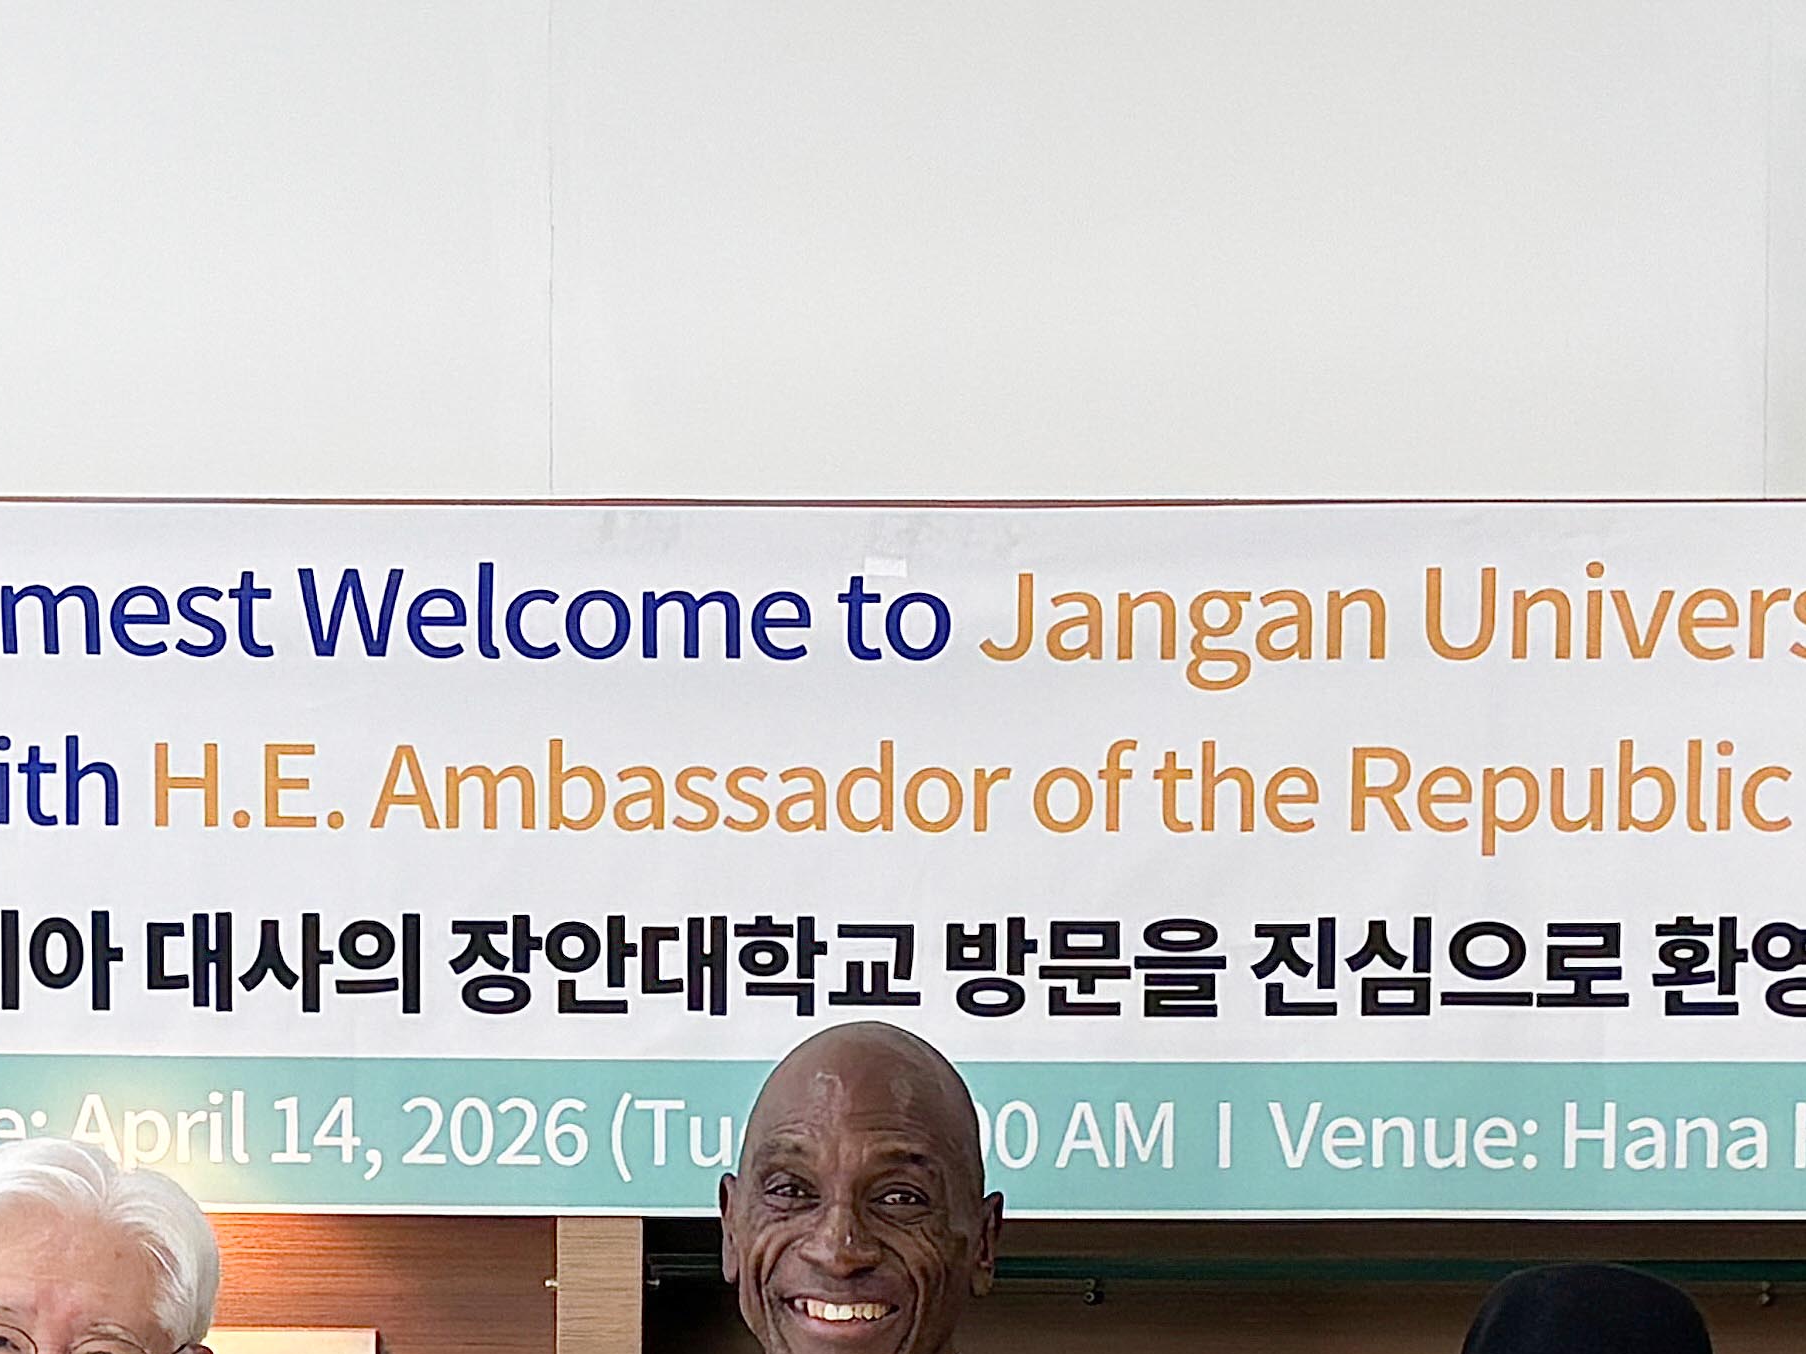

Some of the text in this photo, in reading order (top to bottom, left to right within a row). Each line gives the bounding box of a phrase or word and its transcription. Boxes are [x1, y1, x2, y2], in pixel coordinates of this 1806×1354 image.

[298, 562, 811, 661] Welcome
[838, 576, 951, 662] to
[980, 572, 1385, 692] Jangan
[155, 742, 344, 830] H.E.
[370, 739, 1012, 833] Ambassador
[1033, 739, 1139, 833] of
[1153, 740, 1320, 833] the
[1351, 739, 1792, 856] Republic
[146, 911, 421, 1015] 대사의
[448, 914, 924, 1017] 장안대학교
[945, 916, 1227, 1018] 방문을
[1250, 916, 1630, 1018] 진심으로
[70, 1090, 251, 1170] April
[270, 1095, 384, 1181] 14,
[401, 1096, 590, 1168] 2026
[611, 1091, 749, 1183] (Tu
[1054, 1100, 1175, 1169] AM
[1268, 1100, 1539, 1171] Venue:
[1563, 1100, 1769, 1171] Hana
